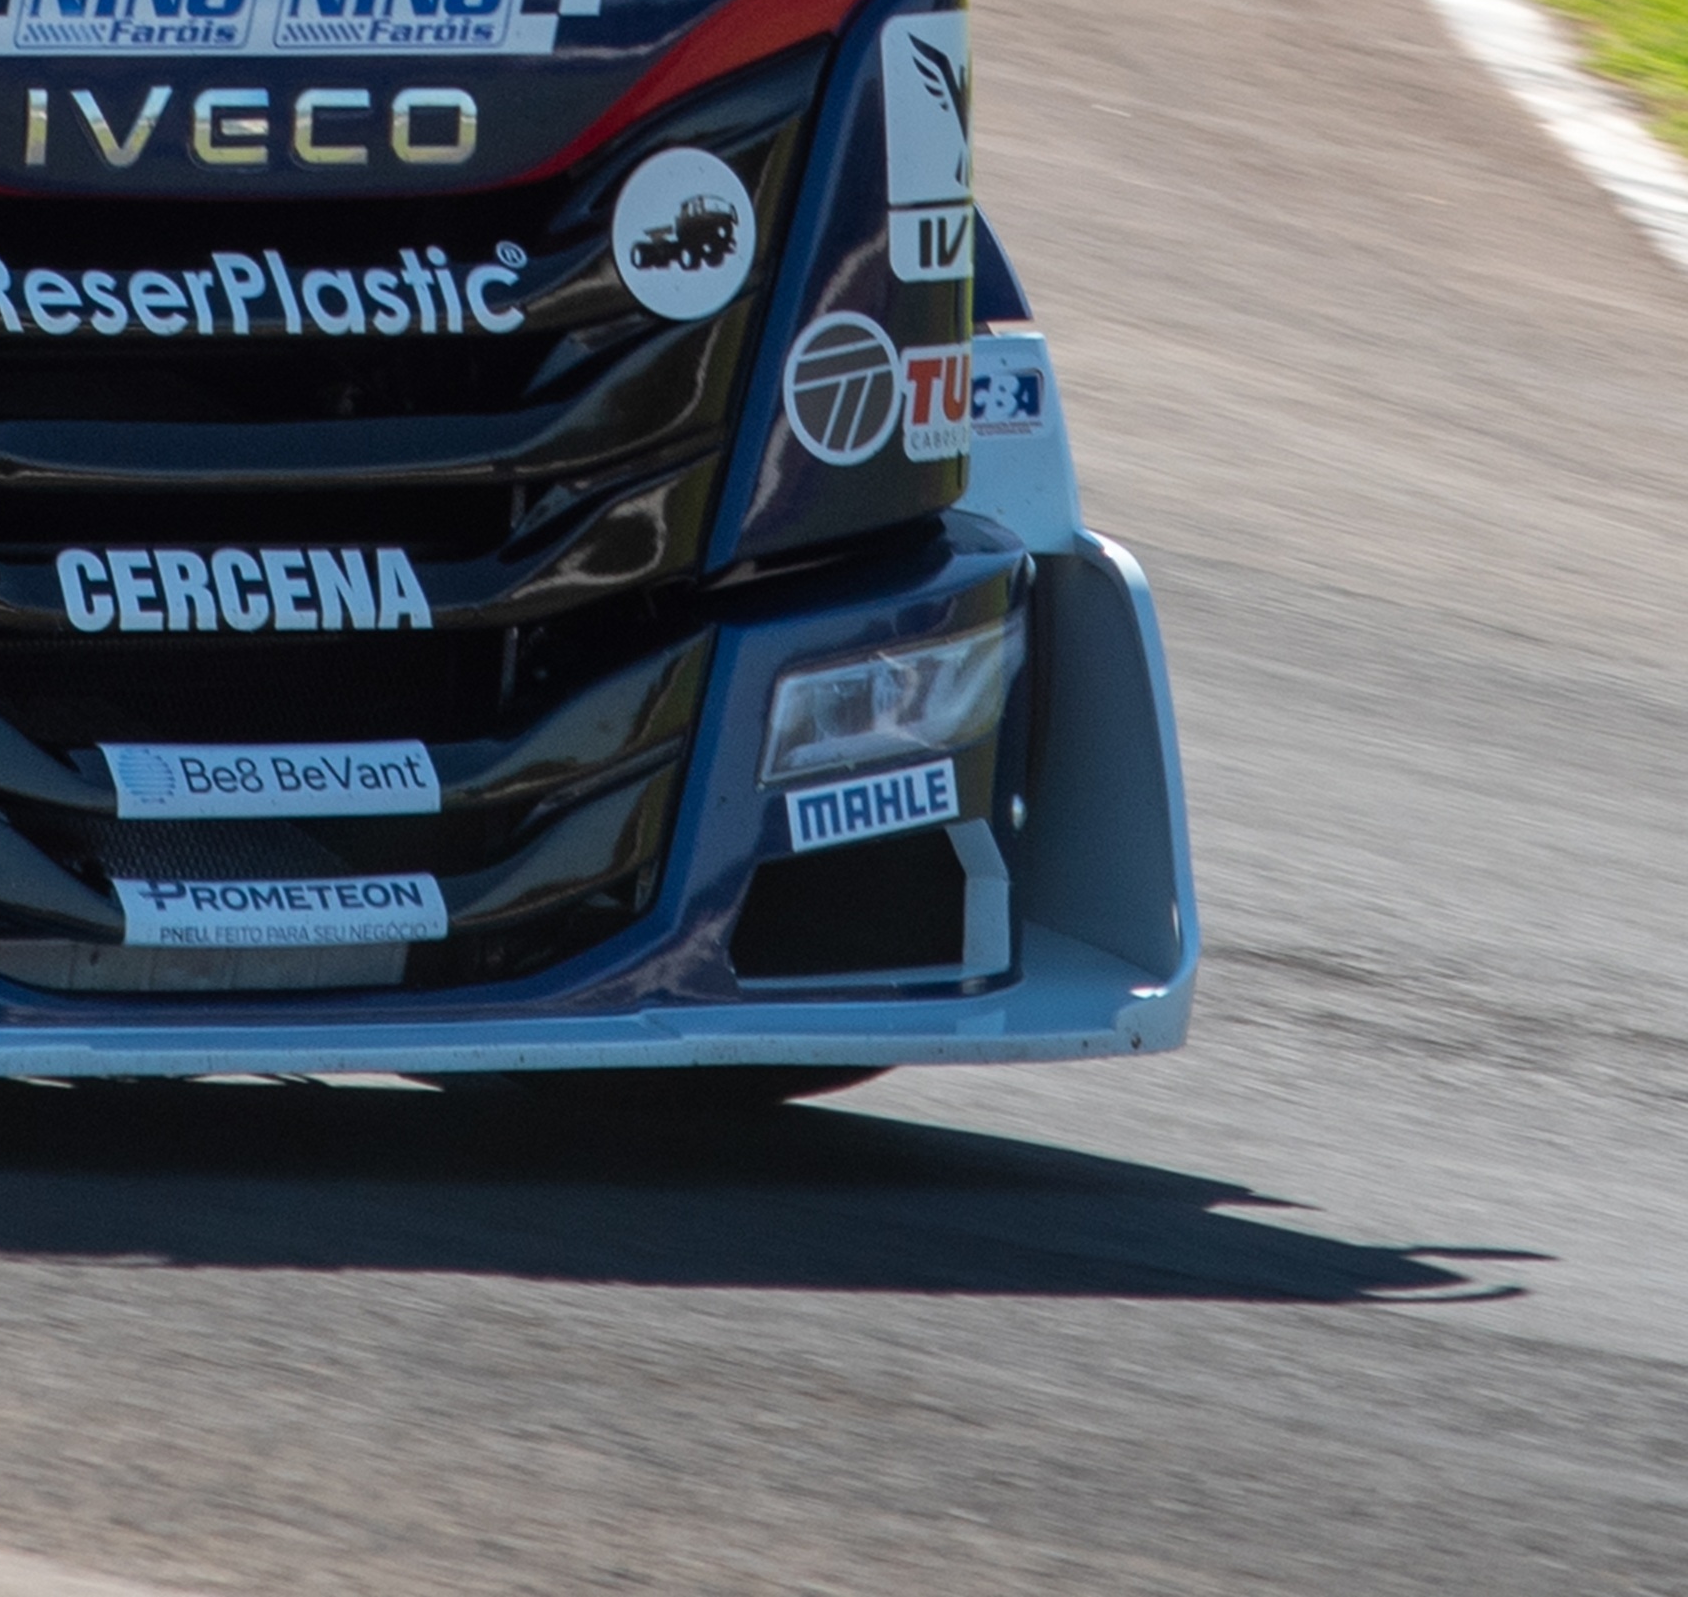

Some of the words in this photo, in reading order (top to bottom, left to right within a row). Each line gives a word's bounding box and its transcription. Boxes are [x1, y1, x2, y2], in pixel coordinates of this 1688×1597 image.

[25, 85, 479, 169] IVECO
[917, 215, 972, 271] IV
[906, 355, 969, 427] TU
[56, 547, 434, 633] CERCENA
[179, 755, 265, 796] Be8
[277, 752, 427, 792] BeVant
[796, 767, 951, 842] MAHLE
[137, 879, 425, 913] PROMETEON
